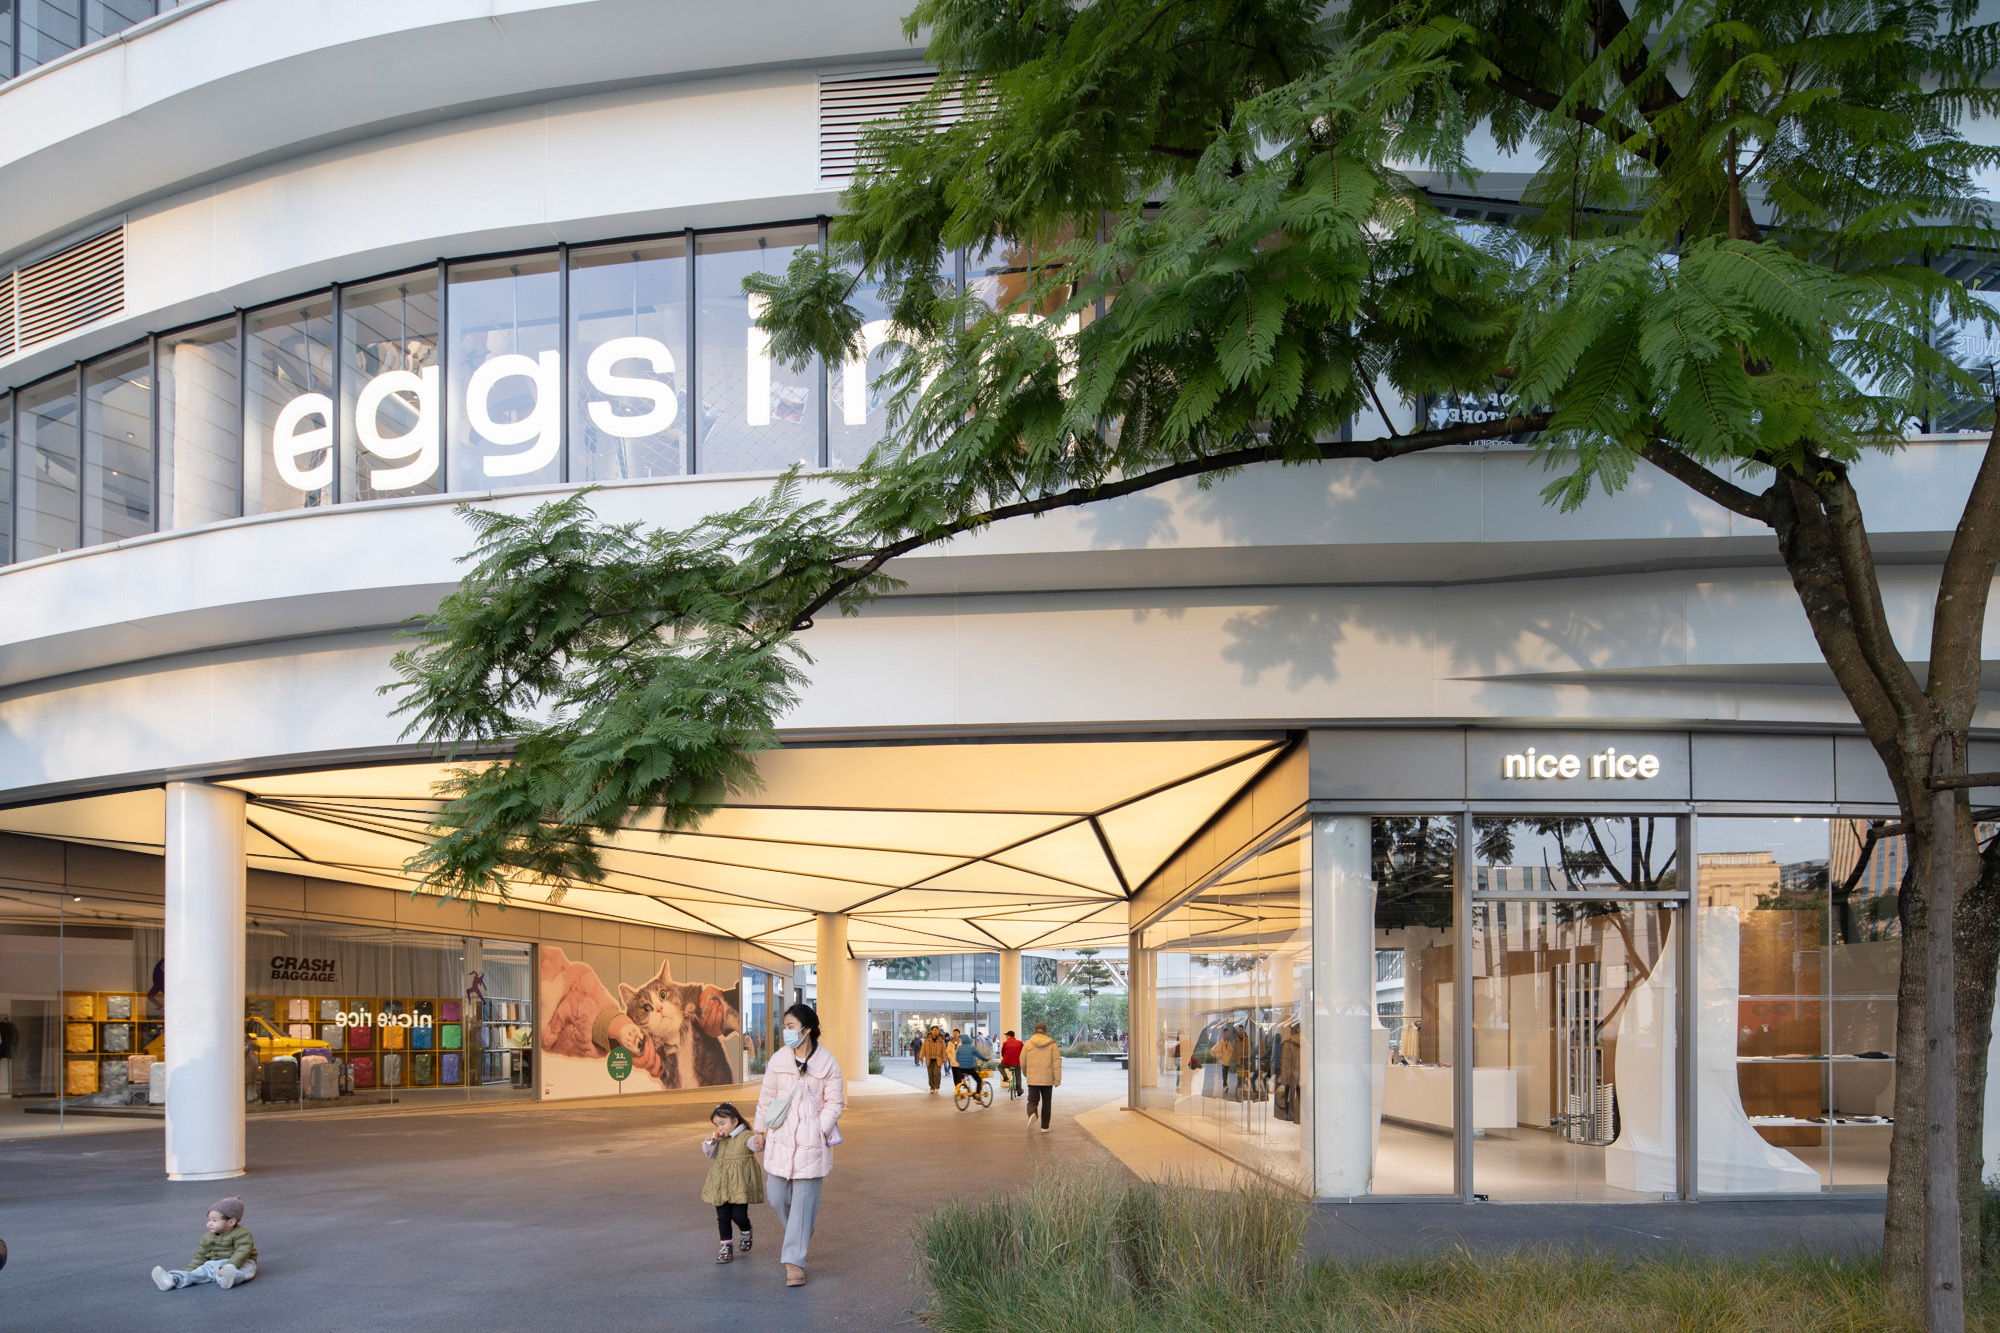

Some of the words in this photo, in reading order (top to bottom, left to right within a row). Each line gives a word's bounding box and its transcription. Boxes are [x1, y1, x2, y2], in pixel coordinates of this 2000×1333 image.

[273, 336, 678, 490] eggs
[1504, 747, 1581, 778] nice
[1591, 747, 1660, 778] rice
[270, 955, 336, 972] CRASH
[270, 970, 336, 983] BAGGAGE
